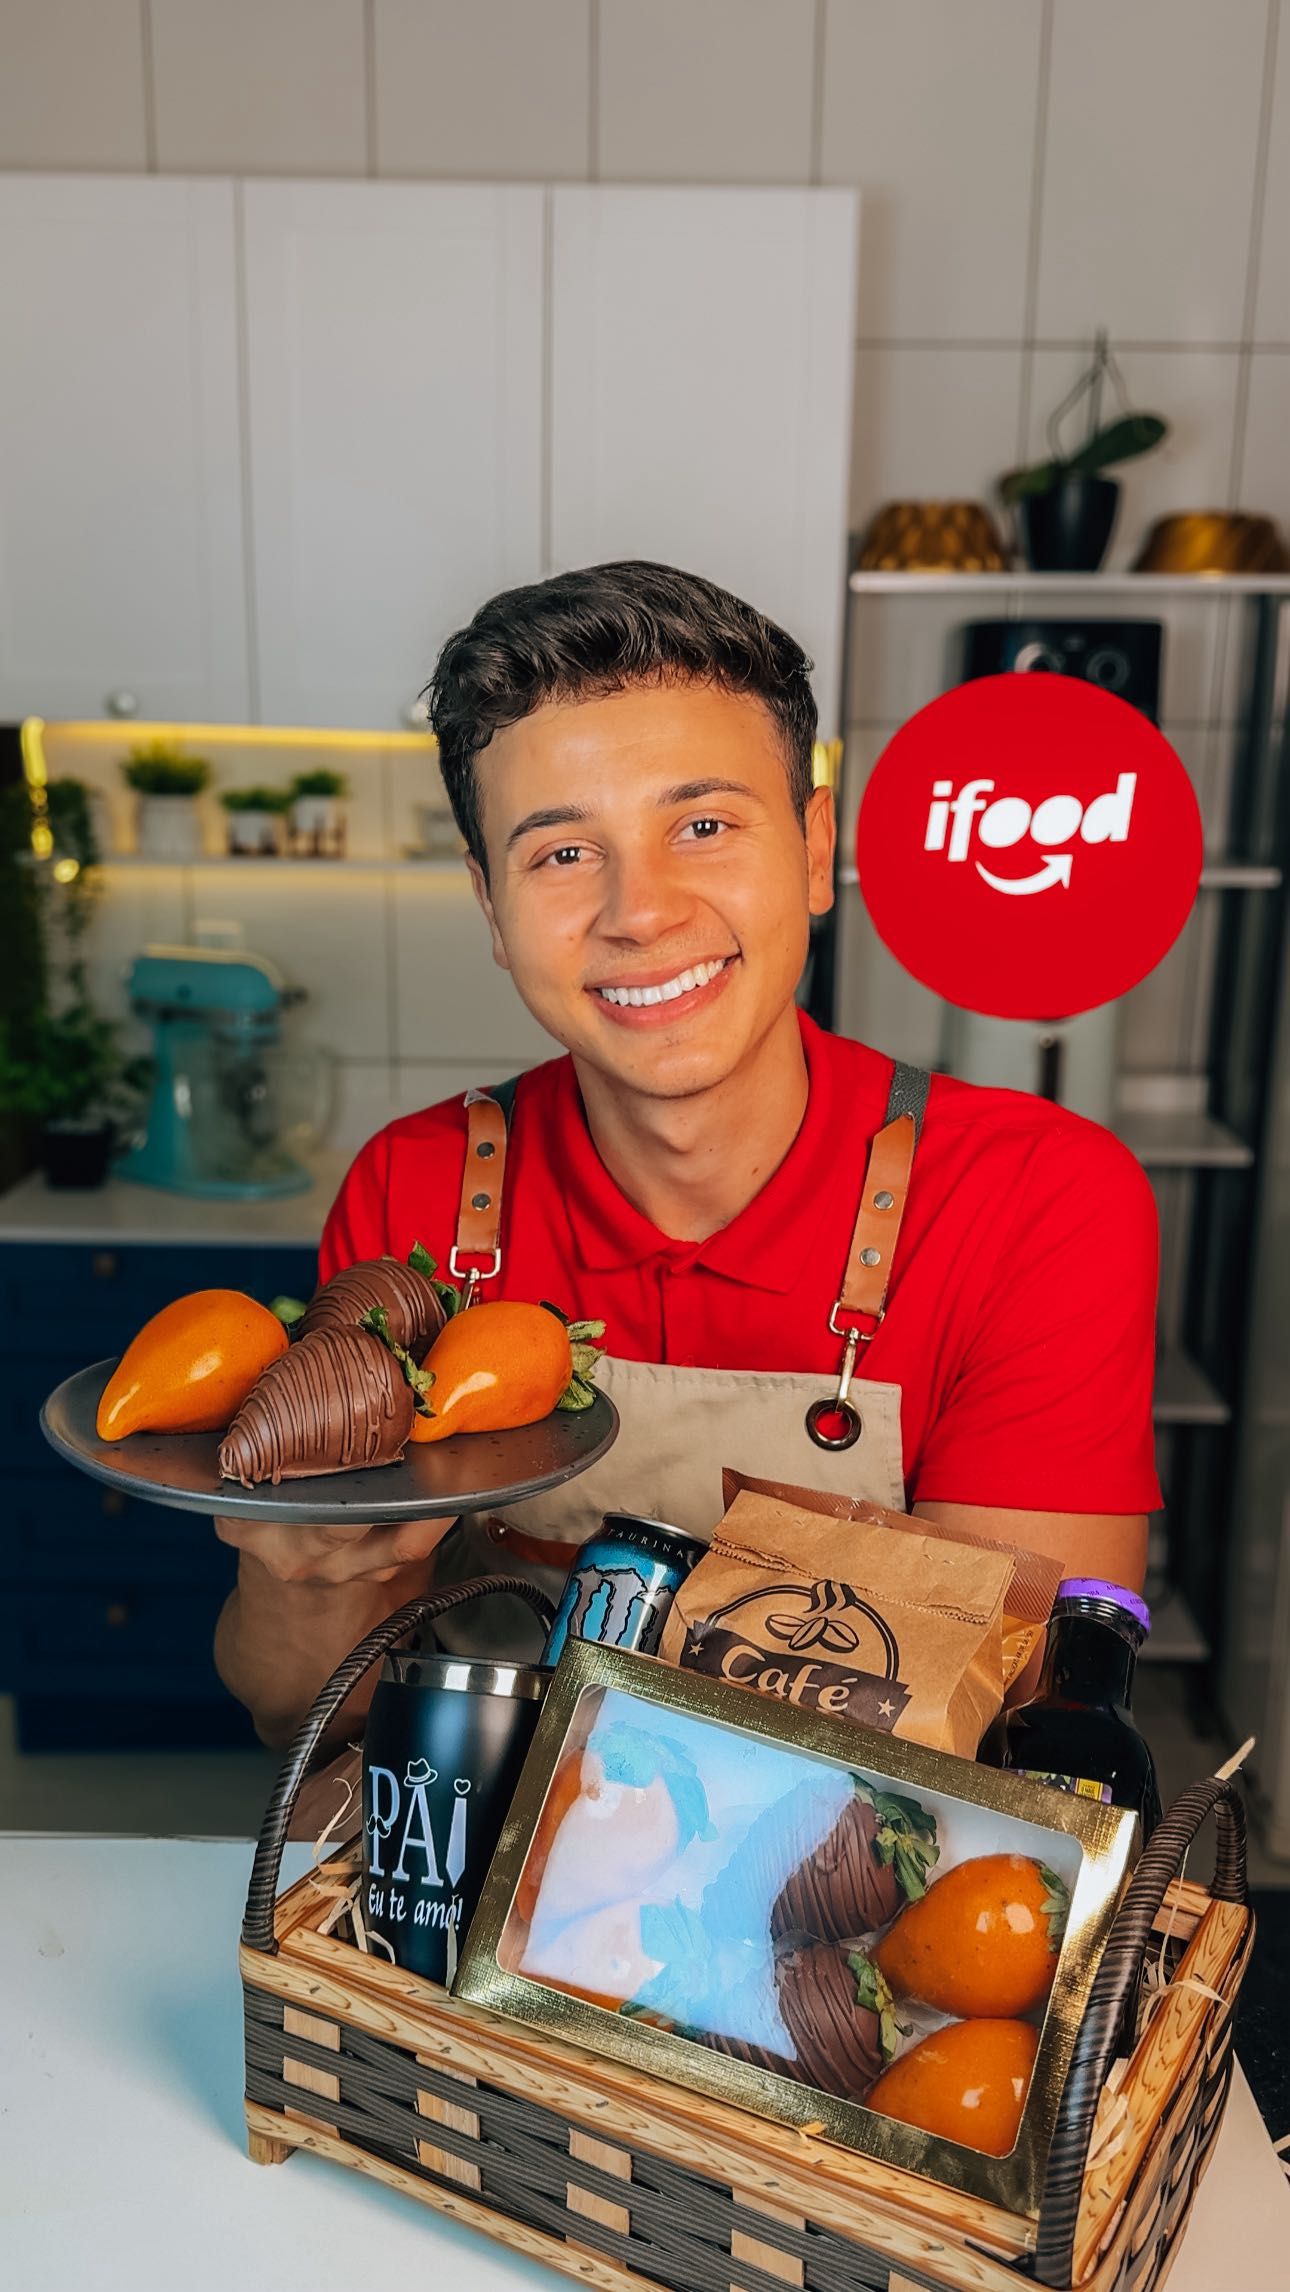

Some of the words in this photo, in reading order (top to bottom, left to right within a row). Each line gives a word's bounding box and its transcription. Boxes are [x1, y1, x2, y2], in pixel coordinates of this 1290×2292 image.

[606, 1528, 684, 1558] TAURINA
[721, 1644, 858, 1712] Café
[368, 1882, 385, 1918] Eu
[389, 1887, 407, 1921] te
[413, 1896, 464, 1931] amo!
